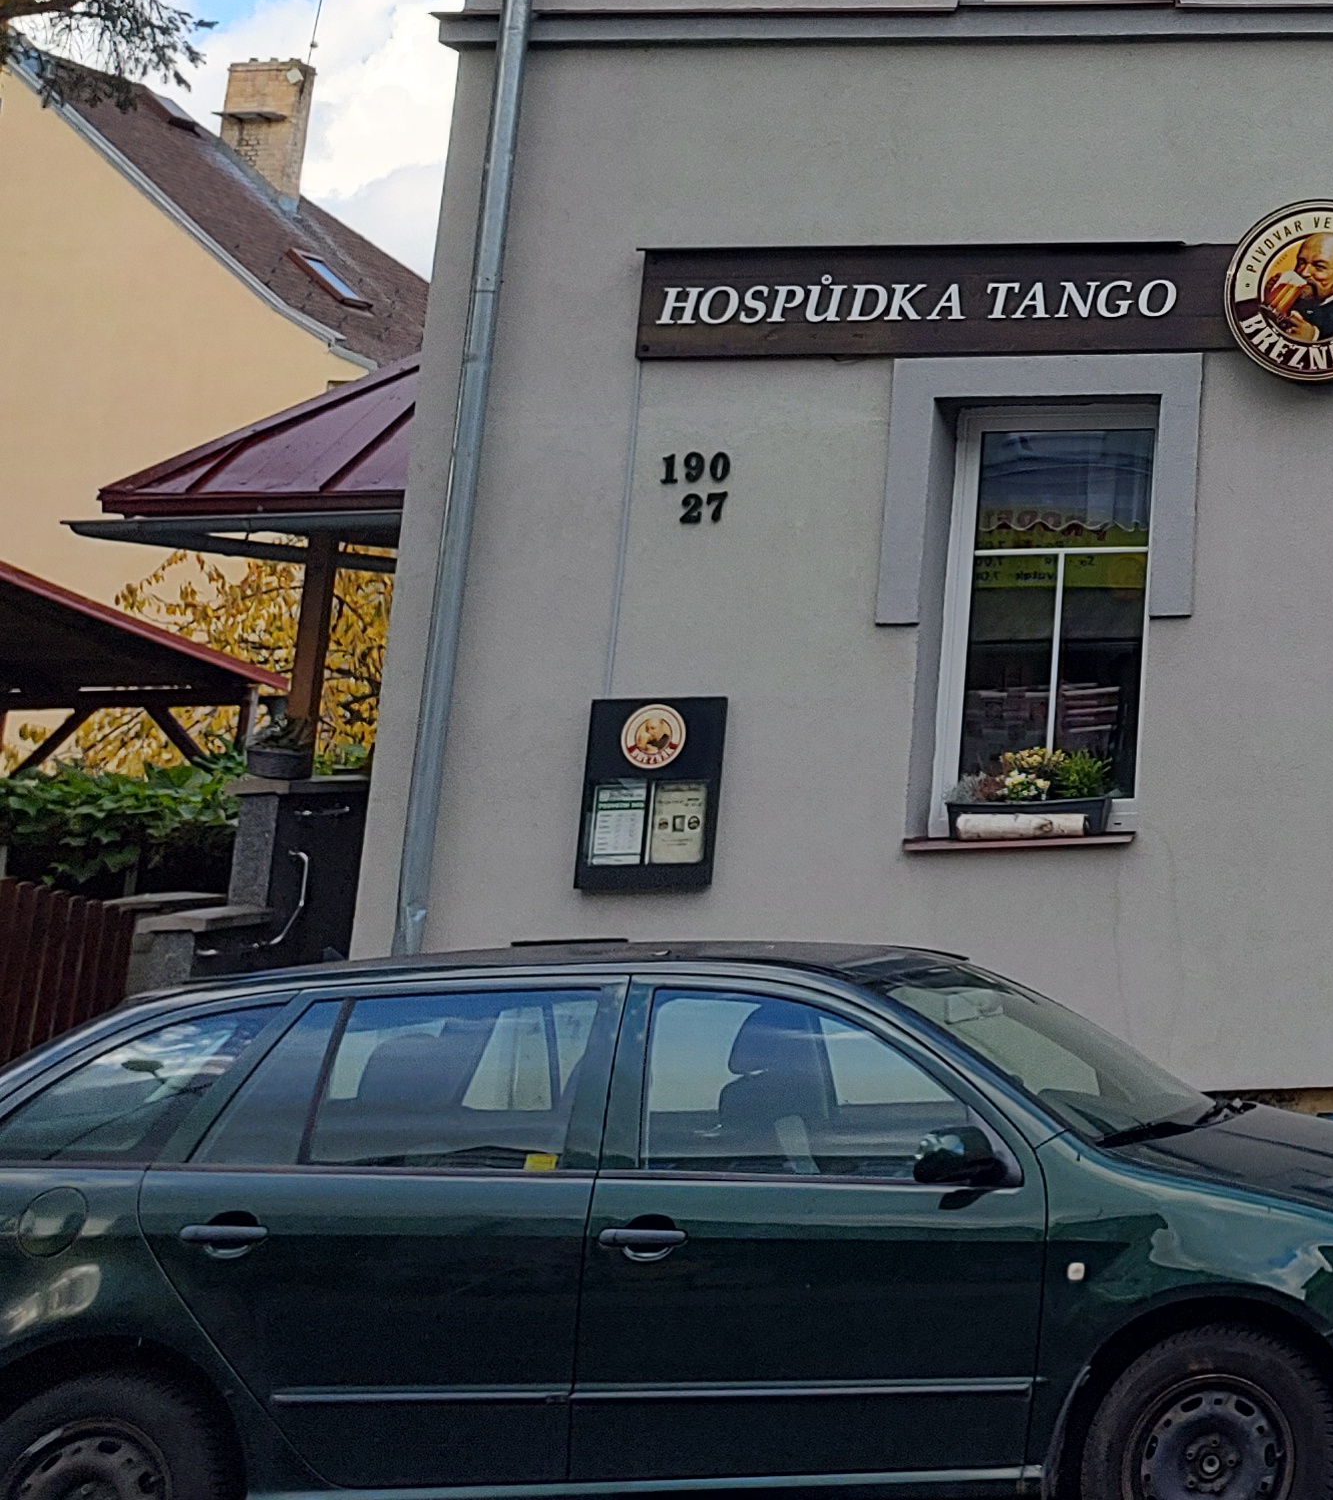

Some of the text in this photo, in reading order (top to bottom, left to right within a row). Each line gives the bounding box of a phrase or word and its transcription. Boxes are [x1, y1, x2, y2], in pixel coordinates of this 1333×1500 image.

[1246, 220, 1303, 273] PIVOVAR
[655, 274, 1178, 324] HOSPŮDKA TANGO
[660, 451, 731, 485] 190
[679, 491, 729, 524] 27
